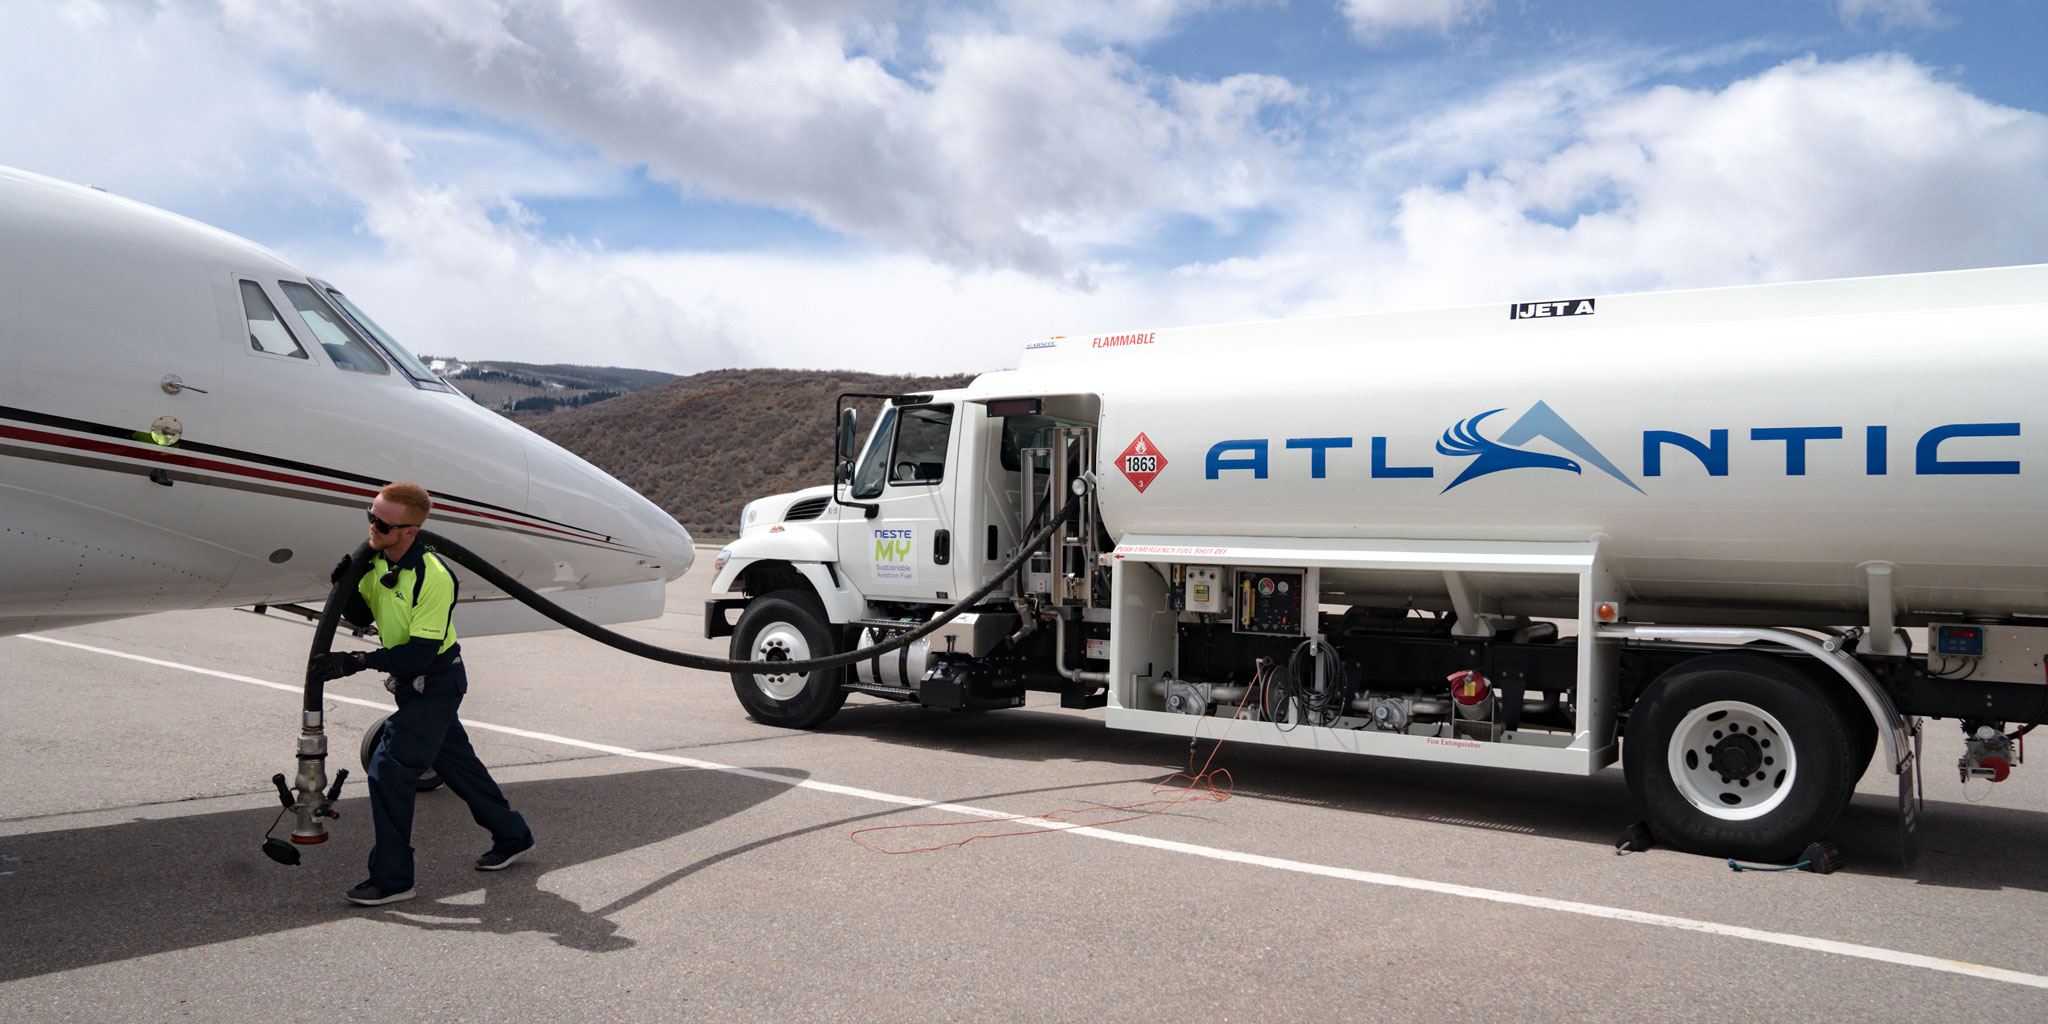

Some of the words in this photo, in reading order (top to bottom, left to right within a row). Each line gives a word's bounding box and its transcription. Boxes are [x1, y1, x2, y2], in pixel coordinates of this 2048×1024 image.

[1520, 302, 1569, 318] JET
[1574, 300, 1594, 315] A
[1092, 332, 1156, 349] FLAMMABLE
[1205, 399, 2022, 496] ATLANTIC
[1126, 456, 1156, 472] 1863
[1138, 480, 1144, 488] 3
[874, 529, 912, 539] NESTE
[875, 539, 911, 562] MY
[1134, 546, 1176, 554] EMERGENCY
[876, 563, 912, 571] Sustainable
[1427, 737, 1440, 745] Fire
[1440, 739, 1482, 749] Extinguisher
